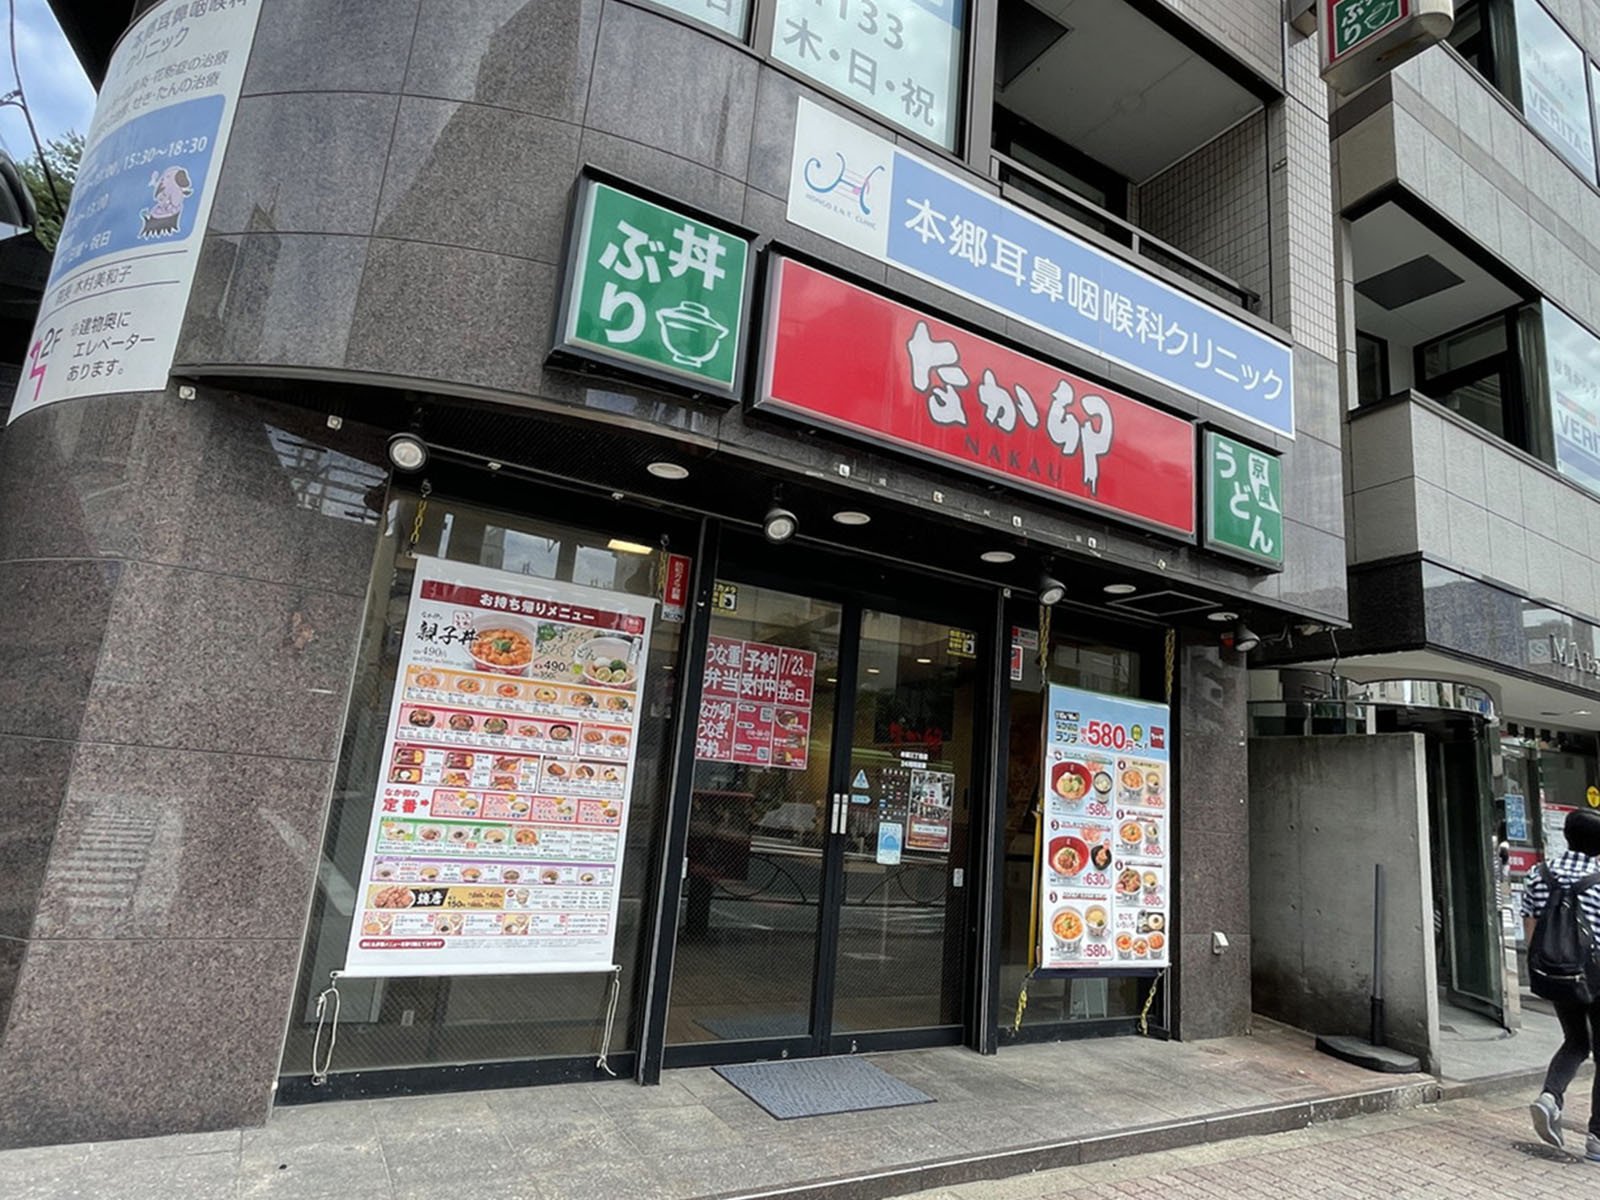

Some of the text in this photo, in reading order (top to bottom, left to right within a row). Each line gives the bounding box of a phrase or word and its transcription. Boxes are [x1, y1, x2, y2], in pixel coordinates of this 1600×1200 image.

[1341, 0, 1372, 46] ぶり
[783, 17, 935, 127] 木・日・祝
[904, 197, 1283, 400] 本郷耳鼻咽喉科クリニック
[40, 327, 64, 359] 2F
[73, 333, 155, 358] エレベーター
[67, 358, 124, 381] あります。
[906, 320, 1114, 496] なか卯
[964, 434, 1062, 482] NAKAU
[1216, 441, 1273, 553] うどん
[480, 593, 595, 621] お持ち帰りメニュー
[415, 620, 479, 646] 親子丼
[707, 642, 741, 668] うな重
[744, 649, 778, 675] 予約
[780, 653, 804, 676] 7/23
[703, 666, 739, 692] 弁当
[740, 672, 777, 698] 受付中
